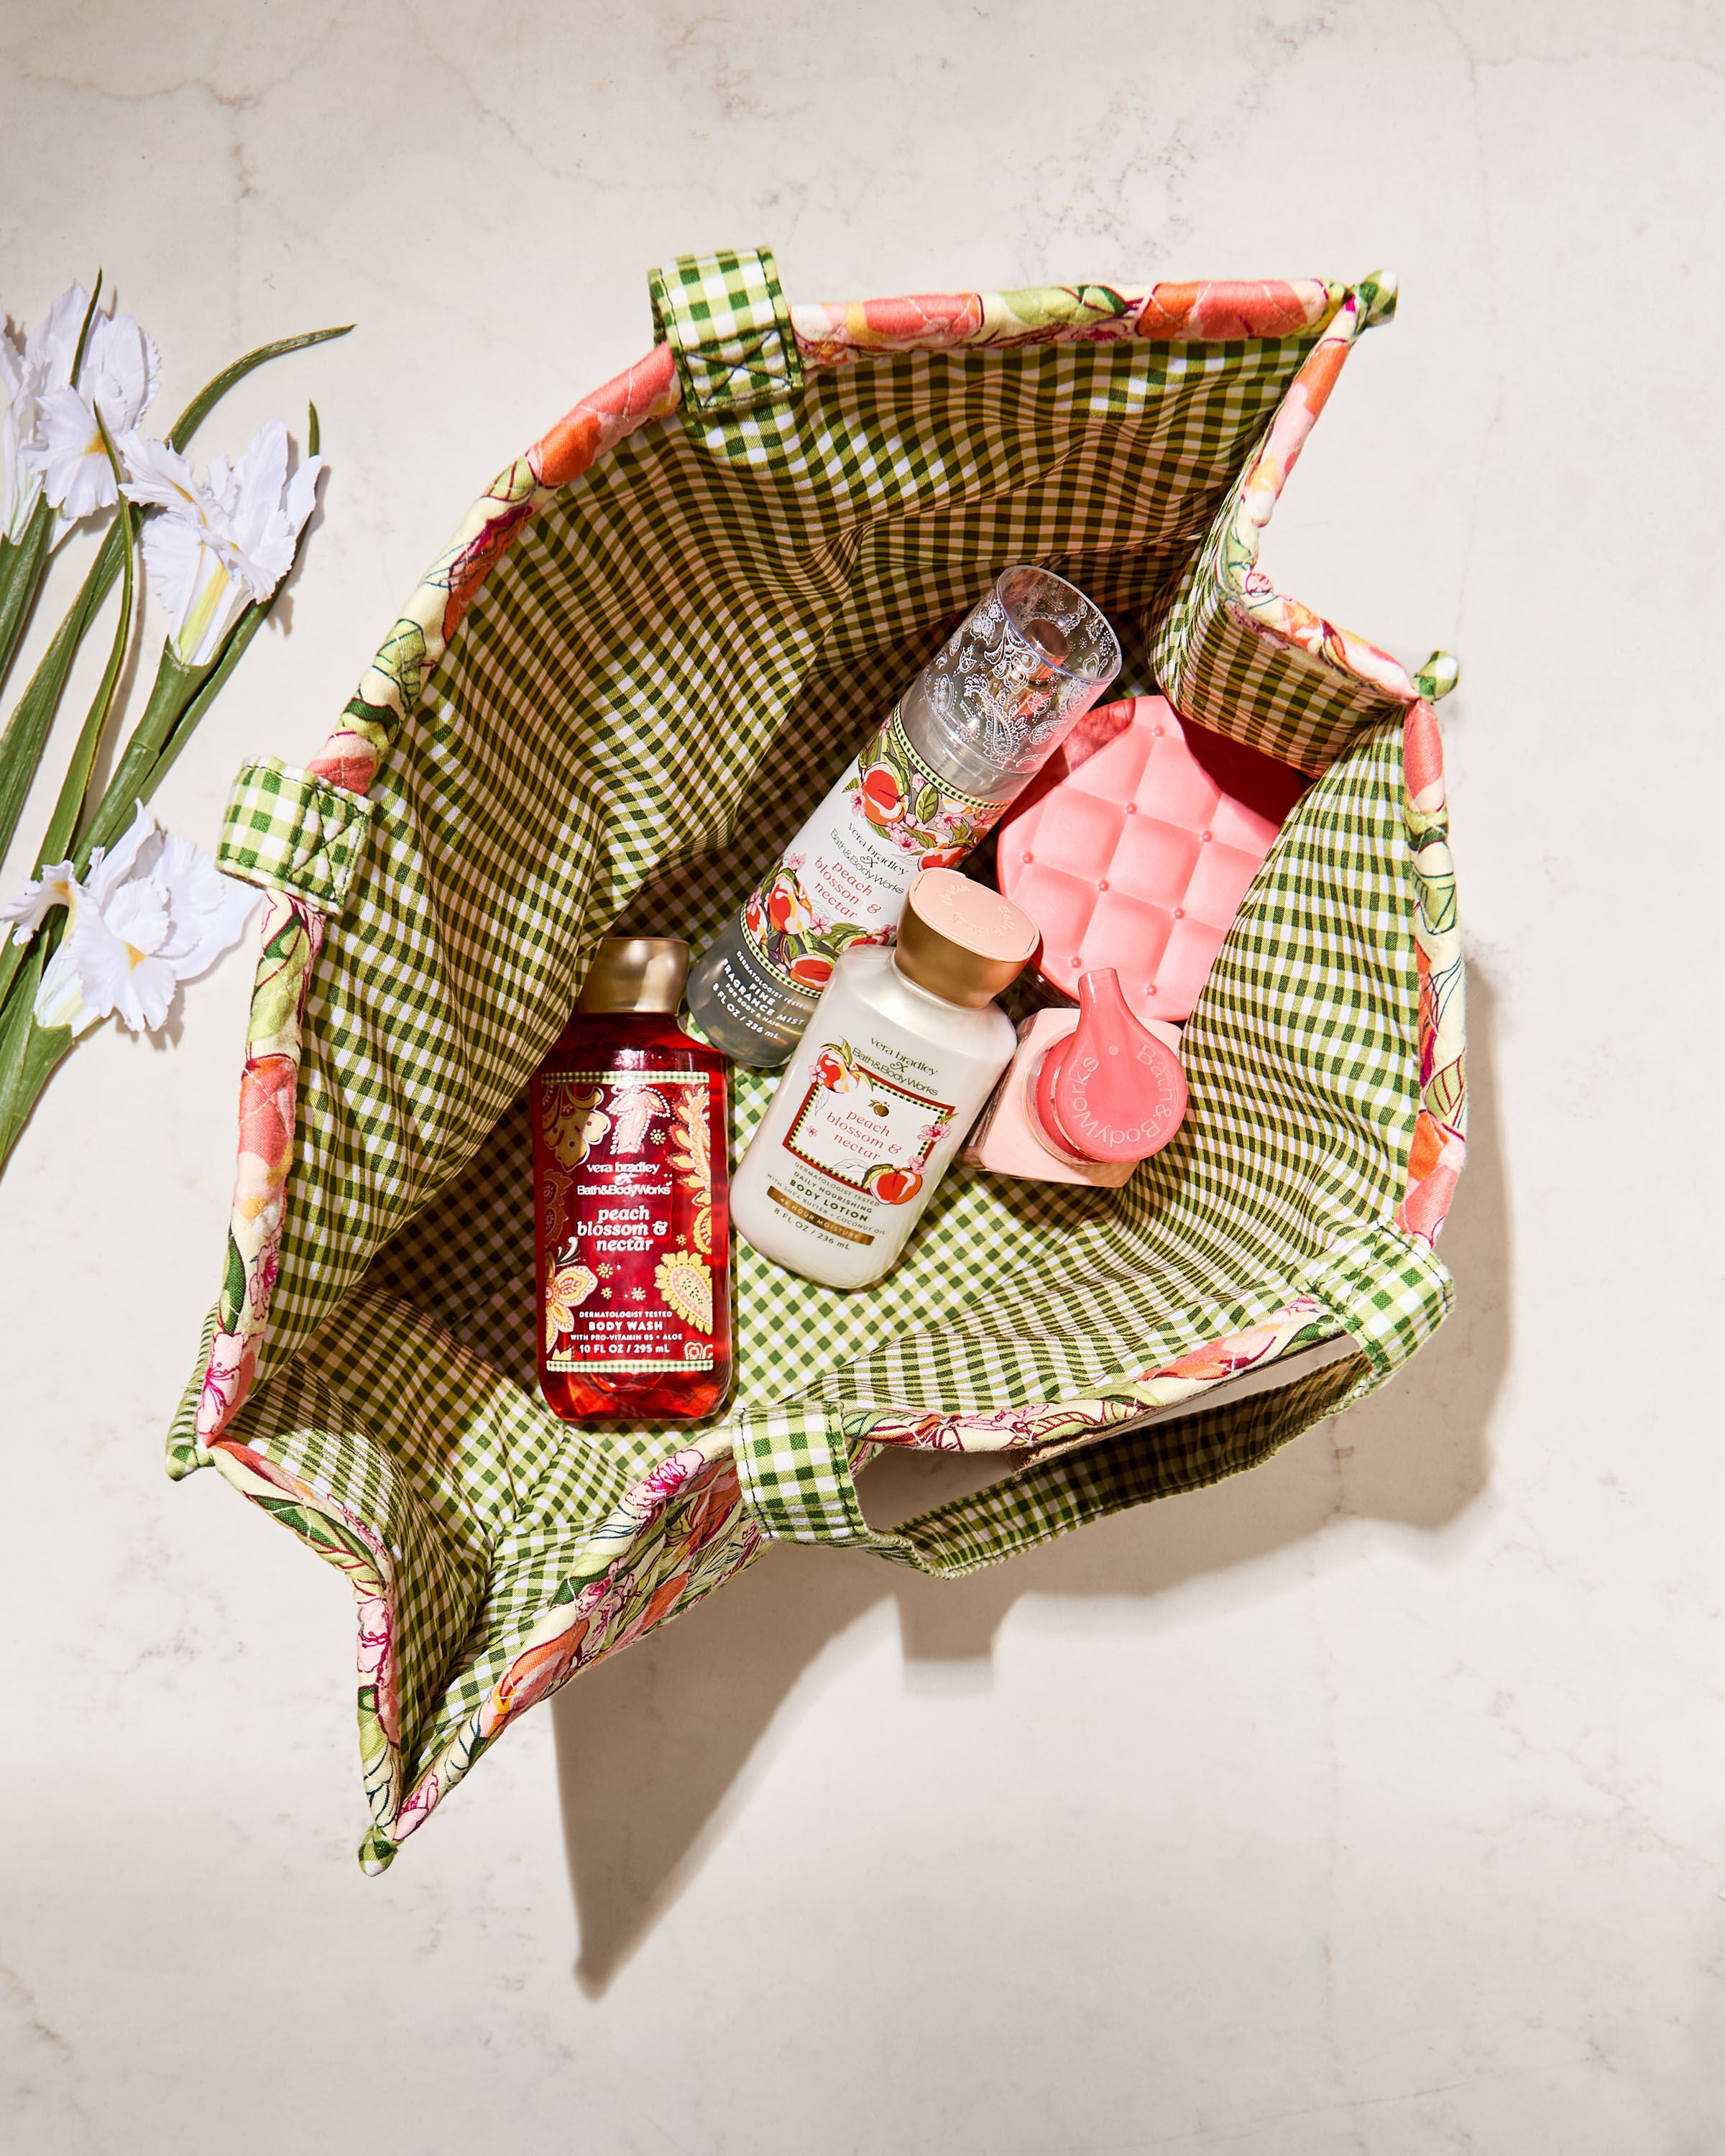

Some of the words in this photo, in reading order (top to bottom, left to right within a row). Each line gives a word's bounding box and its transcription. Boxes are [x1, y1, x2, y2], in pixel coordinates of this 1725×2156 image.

[848, 823, 866, 847] vera
[868, 844, 909, 875] bradley
[814, 857, 862, 906] blossom
[867, 903, 881, 914] &
[832, 862, 873, 896] peach
[814, 883, 857, 918] nectar
[724, 958, 776, 1015] FRAGRANCE
[776, 1014, 804, 1026] MIST
[736, 951, 783, 999] DERMATOLOGIST
[749, 983, 776, 1006] FINE
[717, 990, 726, 1004] FL
[727, 1003, 741, 1017] OZ
[745, 1018, 763, 1033] 236
[764, 1031, 779, 1040] mL
[726, 983, 737, 998] FOR
[737, 995, 755, 1014] BODY
[762, 1016, 780, 1027] HAIR
[871, 1038, 893, 1056] vera
[896, 1051, 939, 1075] bradley
[827, 1112, 883, 1148] blossom
[888, 1143, 902, 1154] &
[845, 1110, 891, 1137] peach
[834, 1133, 880, 1161] nectar
[615, 1162, 660, 1174] bradley
[794, 1162, 852, 1194] DERMATOLOGIST
[853, 1192, 880, 1207] TESTED
[768, 1174, 782, 1186] WITH
[783, 1184, 801, 1199] SHEA
[802, 1197, 828, 1215] BUTTER
[837, 1215, 872, 1233] COCONUT
[789, 1179, 819, 1200] BODY
[823, 1198, 868, 1222] LOTION
[794, 1171, 816, 1187] DAILY
[819, 1189, 872, 1213] NOURISHING
[577, 1222, 648, 1236] blossom
[652, 1221, 668, 1235] &
[598, 1206, 650, 1222] peach
[780, 1196, 790, 1206] 48
[792, 1203, 814, 1221] HOUR
[816, 1218, 859, 1240] MOISTURE
[782, 1212, 793, 1222] FL
[795, 1220, 808, 1233] OZ
[817, 1233, 834, 1243] 236
[597, 1238, 653, 1251] nectar
[589, 1322, 623, 1331] BODY
[627, 1322, 663, 1330] WASH
